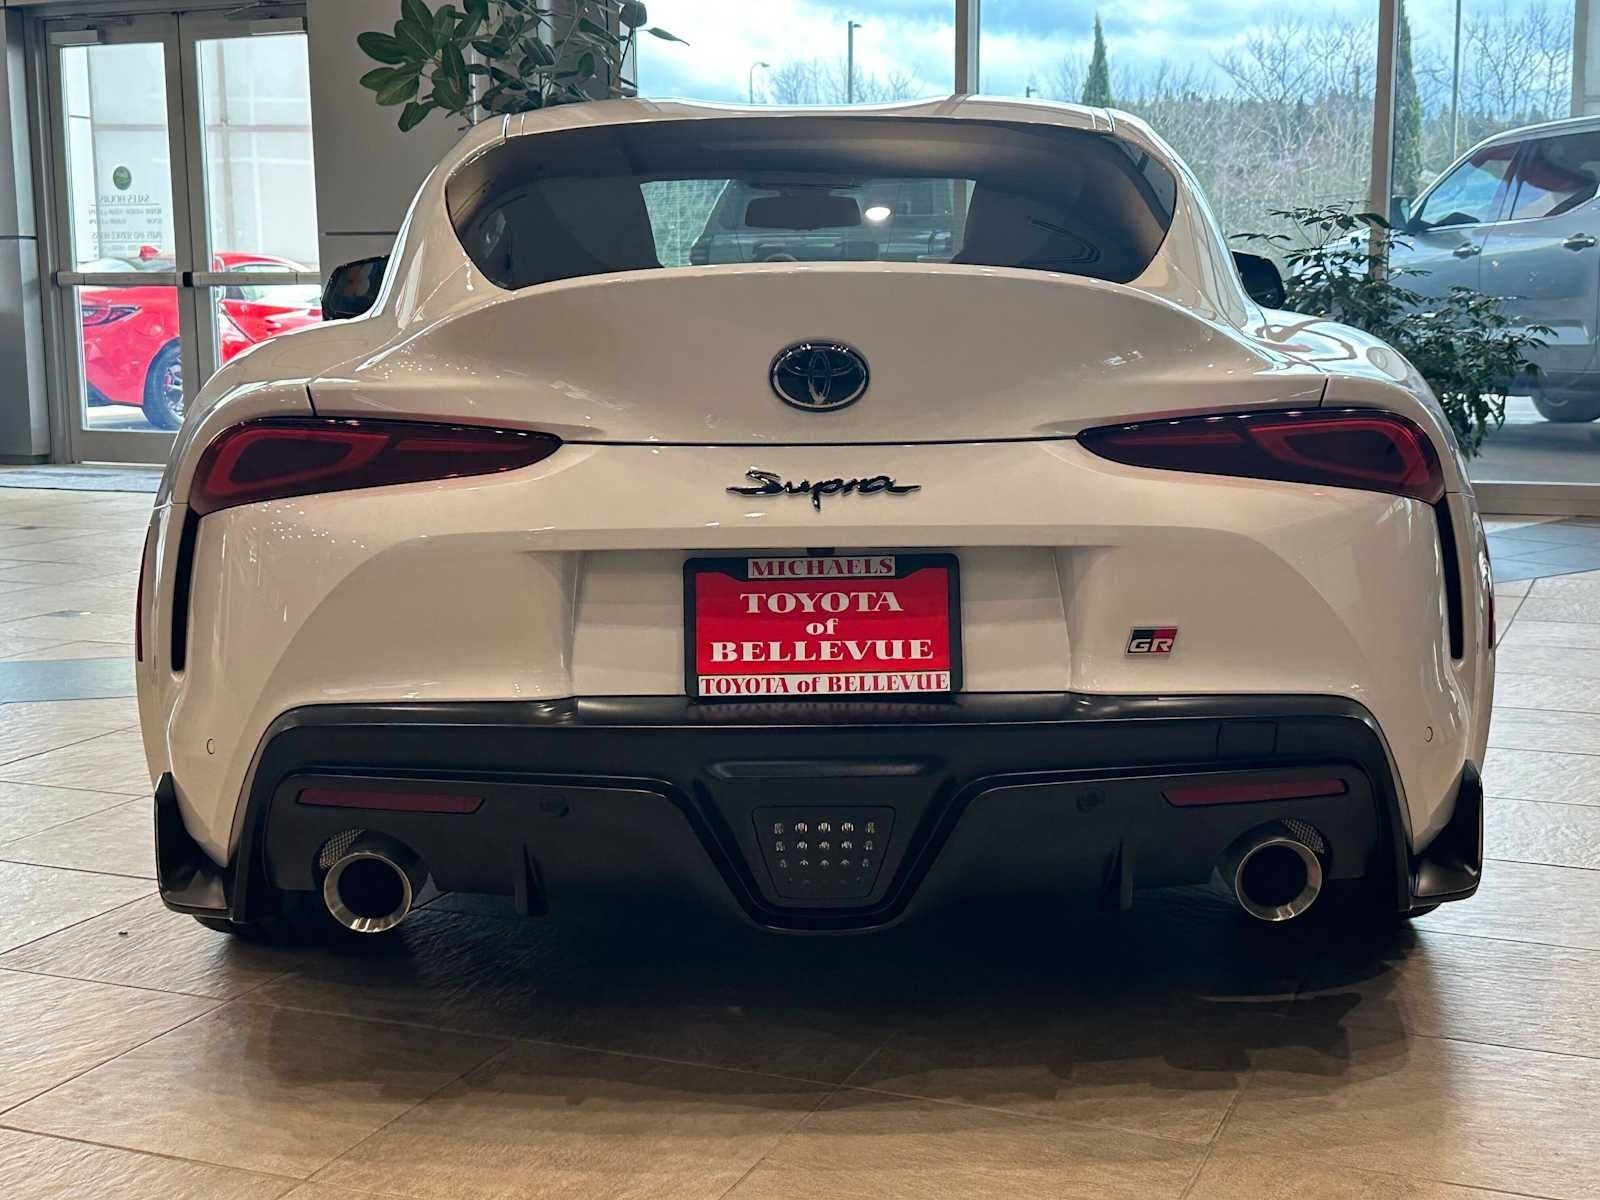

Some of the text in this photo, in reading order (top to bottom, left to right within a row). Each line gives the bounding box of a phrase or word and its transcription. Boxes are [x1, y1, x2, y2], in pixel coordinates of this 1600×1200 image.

[726, 466, 922, 512] Supra
[751, 558, 893, 577] MICHAELS
[740, 591, 904, 614] TOYOTA
[805, 618, 838, 635] of
[710, 639, 934, 662] BELLEVUE
[1129, 638, 1173, 652] GR
[700, 672, 949, 695] TOYOTA of BELLEVUE
